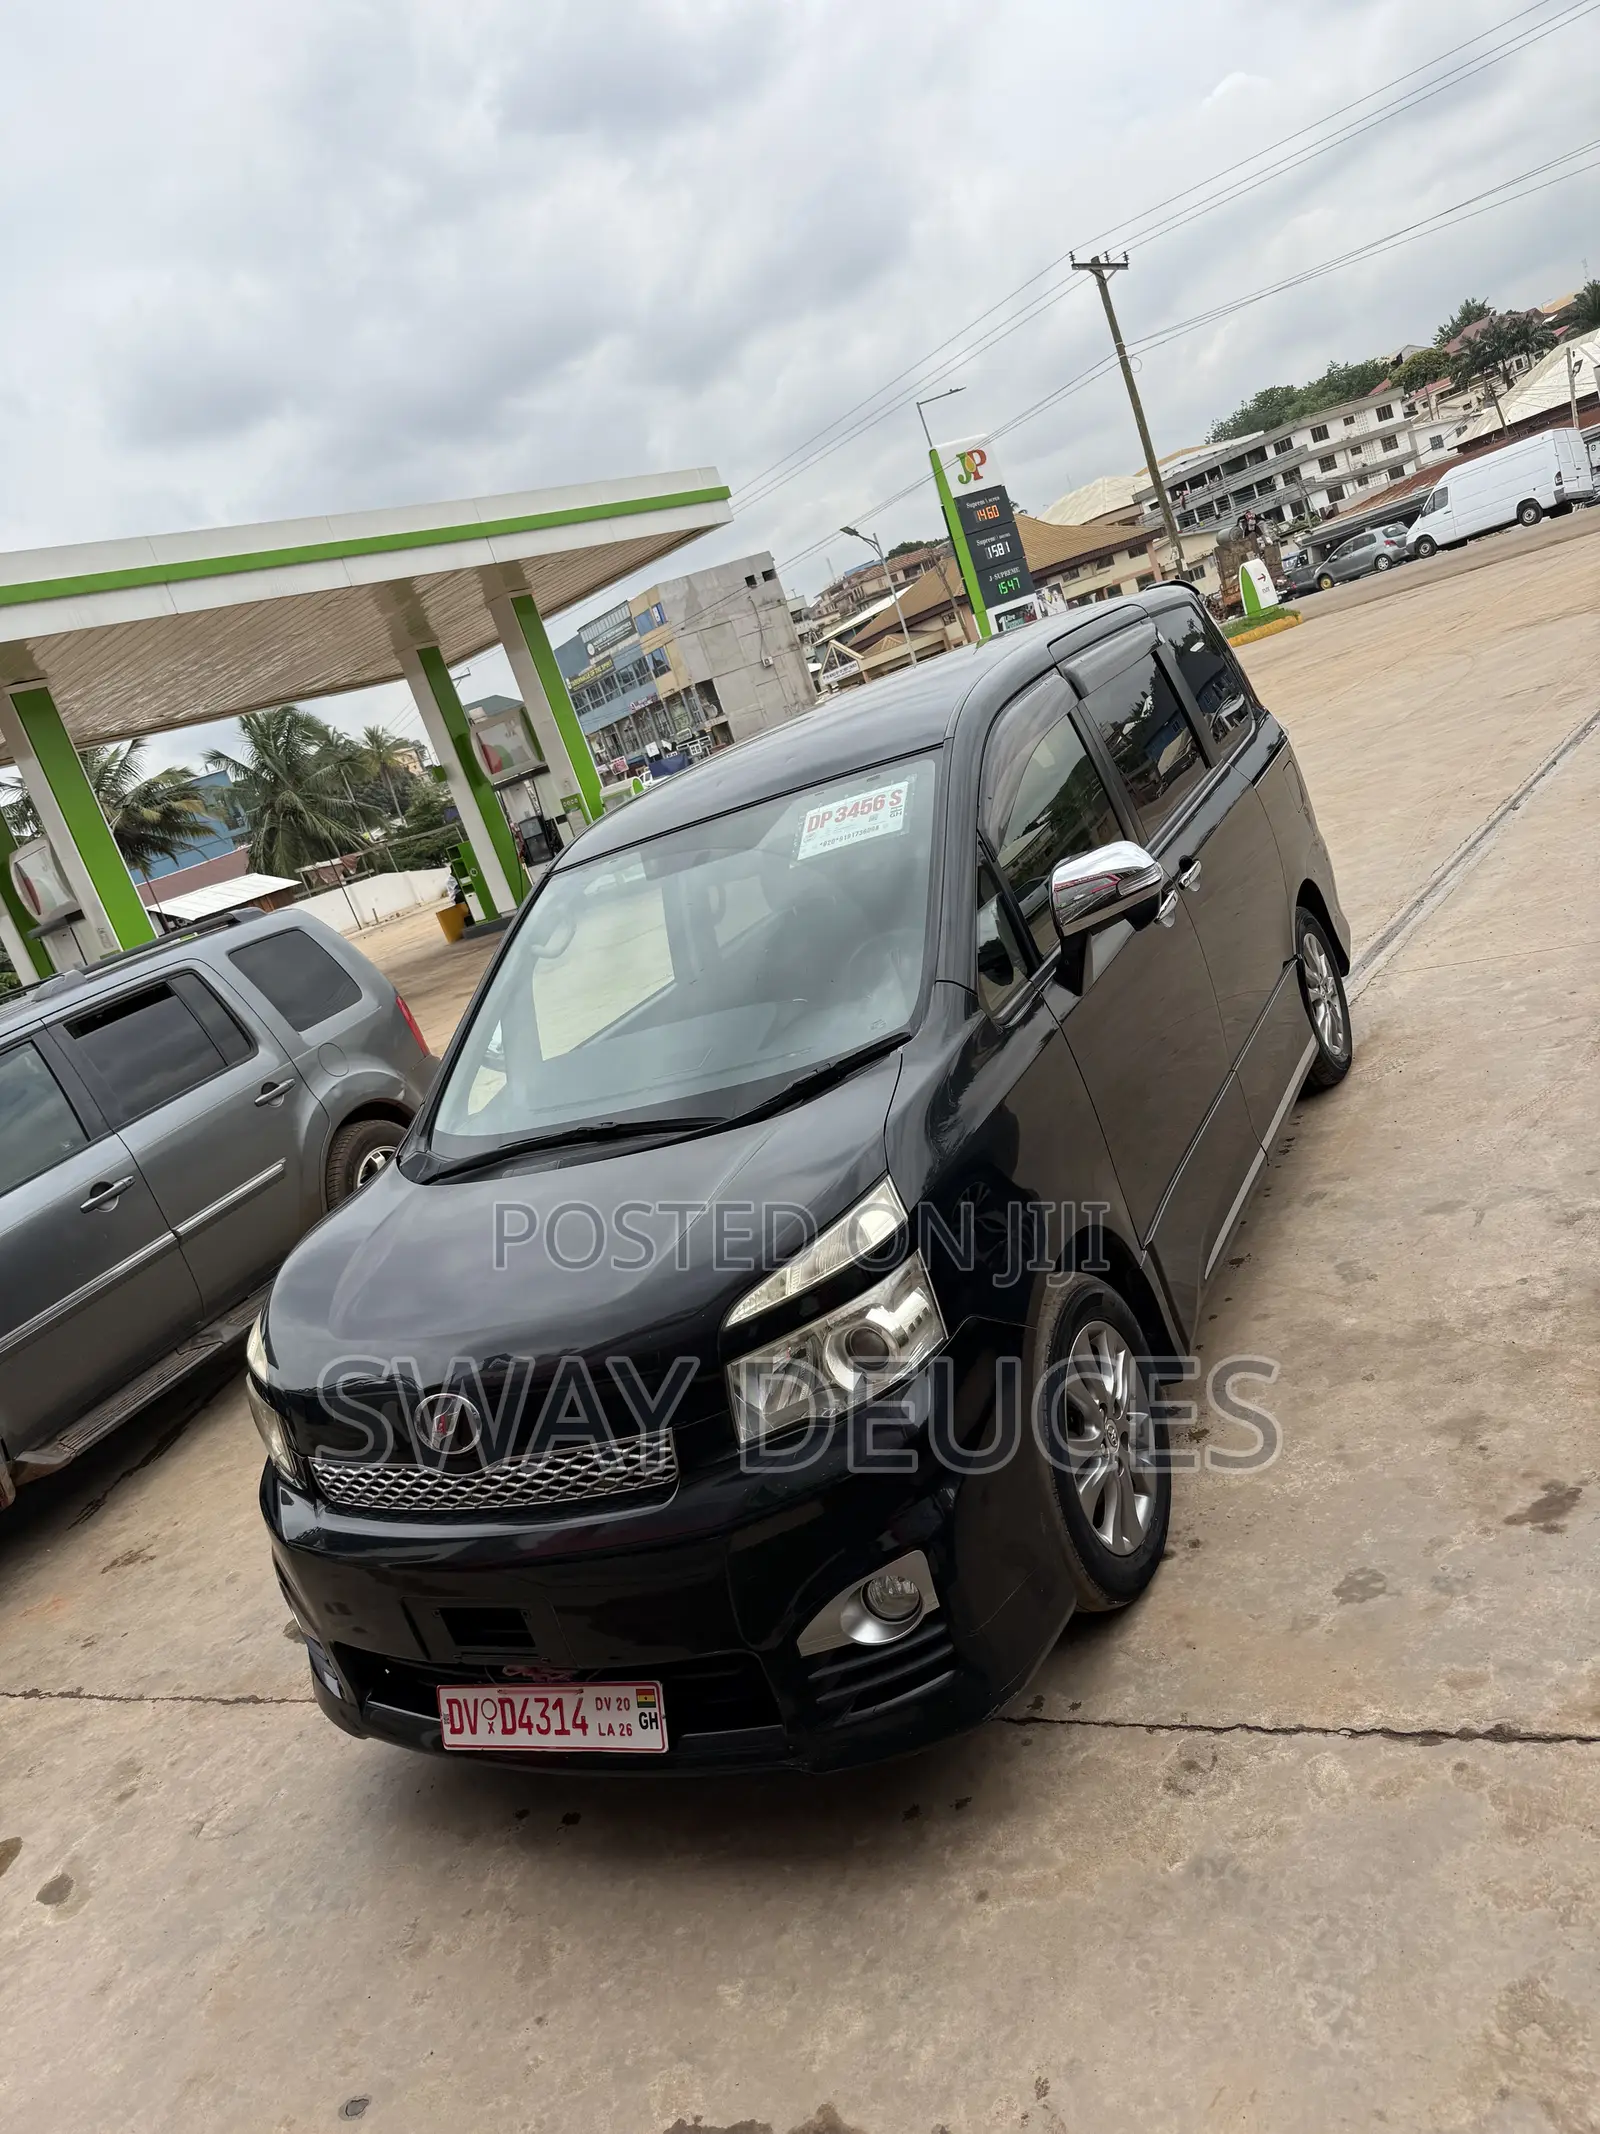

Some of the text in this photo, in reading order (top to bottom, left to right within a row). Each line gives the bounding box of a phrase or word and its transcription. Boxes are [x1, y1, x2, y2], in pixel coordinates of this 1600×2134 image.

[977, 505, 999, 521] 1460
[988, 541, 1011, 558] 1581
[999, 577, 1020, 594] 1547
[807, 811, 832, 832] DP
[834, 794, 886, 823] 3456
[888, 789, 904, 807] S
[594, 1696, 631, 1711] DV 20
[446, 1698, 479, 1735] DV
[500, 1697, 589, 1736] D4314
[638, 1711, 659, 1730] GH
[597, 1722, 633, 1736] LA 26
